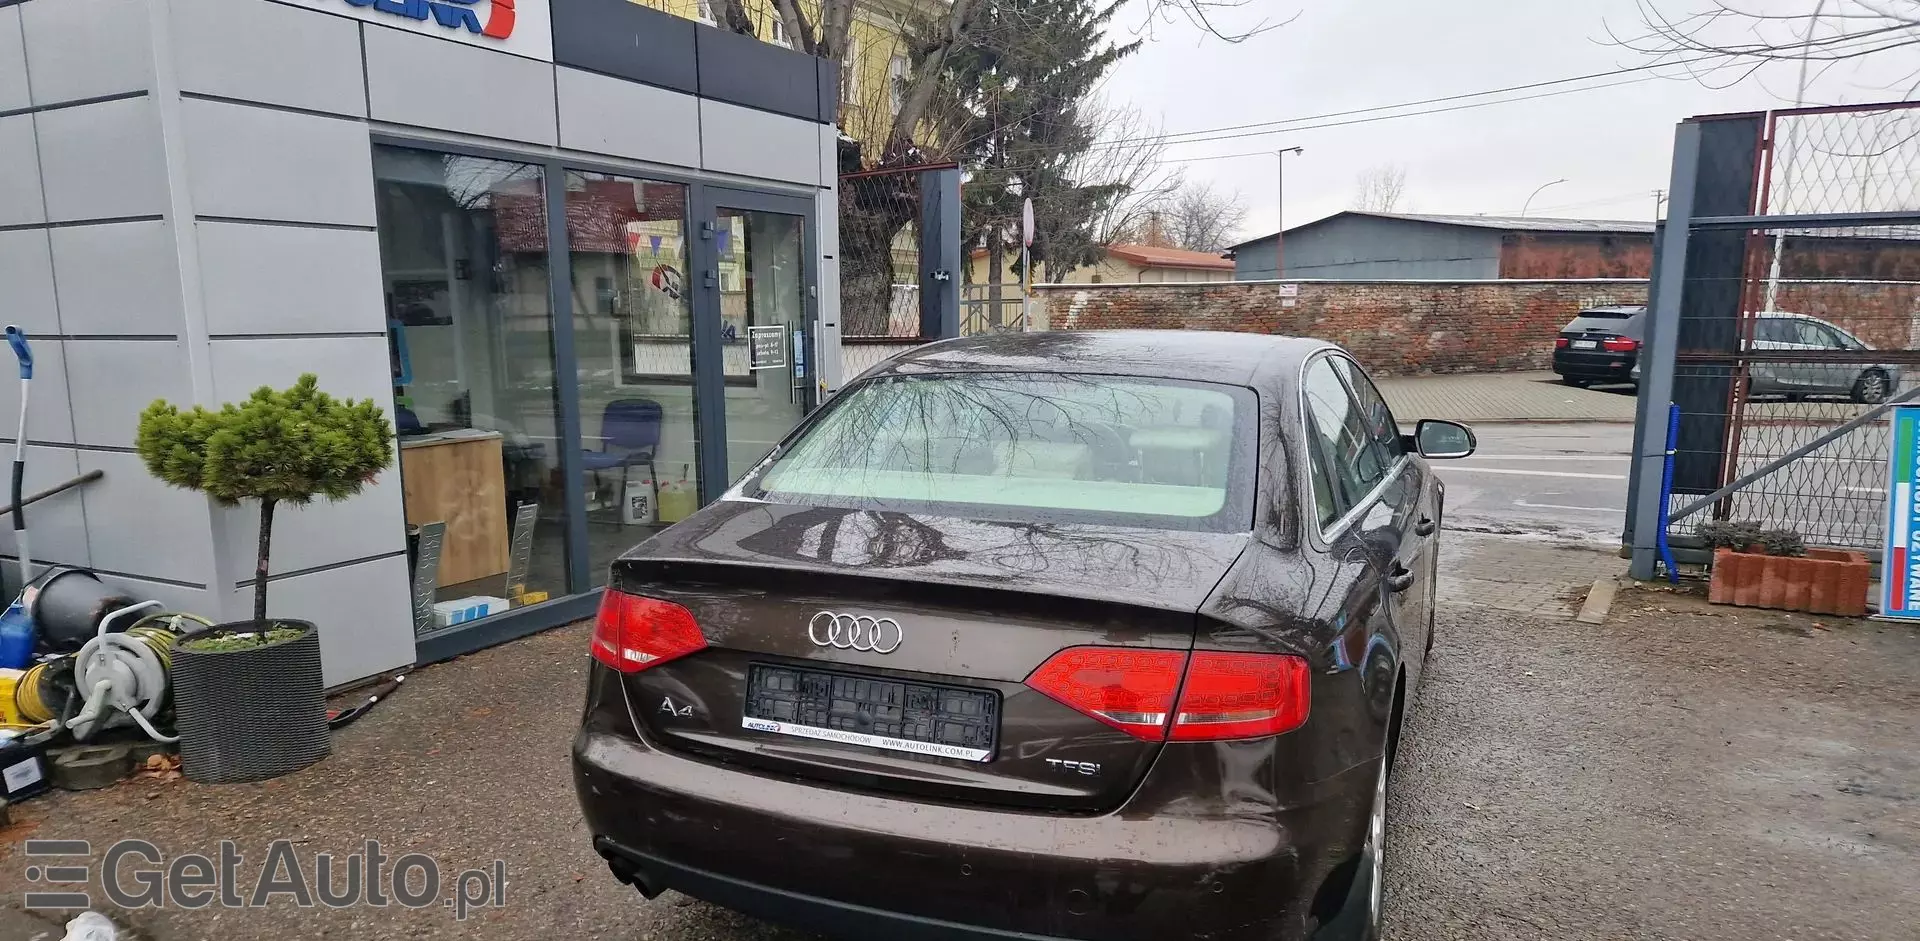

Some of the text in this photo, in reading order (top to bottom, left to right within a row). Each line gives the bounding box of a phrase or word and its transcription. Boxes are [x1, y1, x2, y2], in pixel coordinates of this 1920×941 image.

[661, 697, 692, 717] A4
[748, 722, 777, 732] AUTOLINK
[883, 739, 975, 757] WWW.AUTOLINK.COM.PL
[1045, 758, 1101, 776] TFSI
